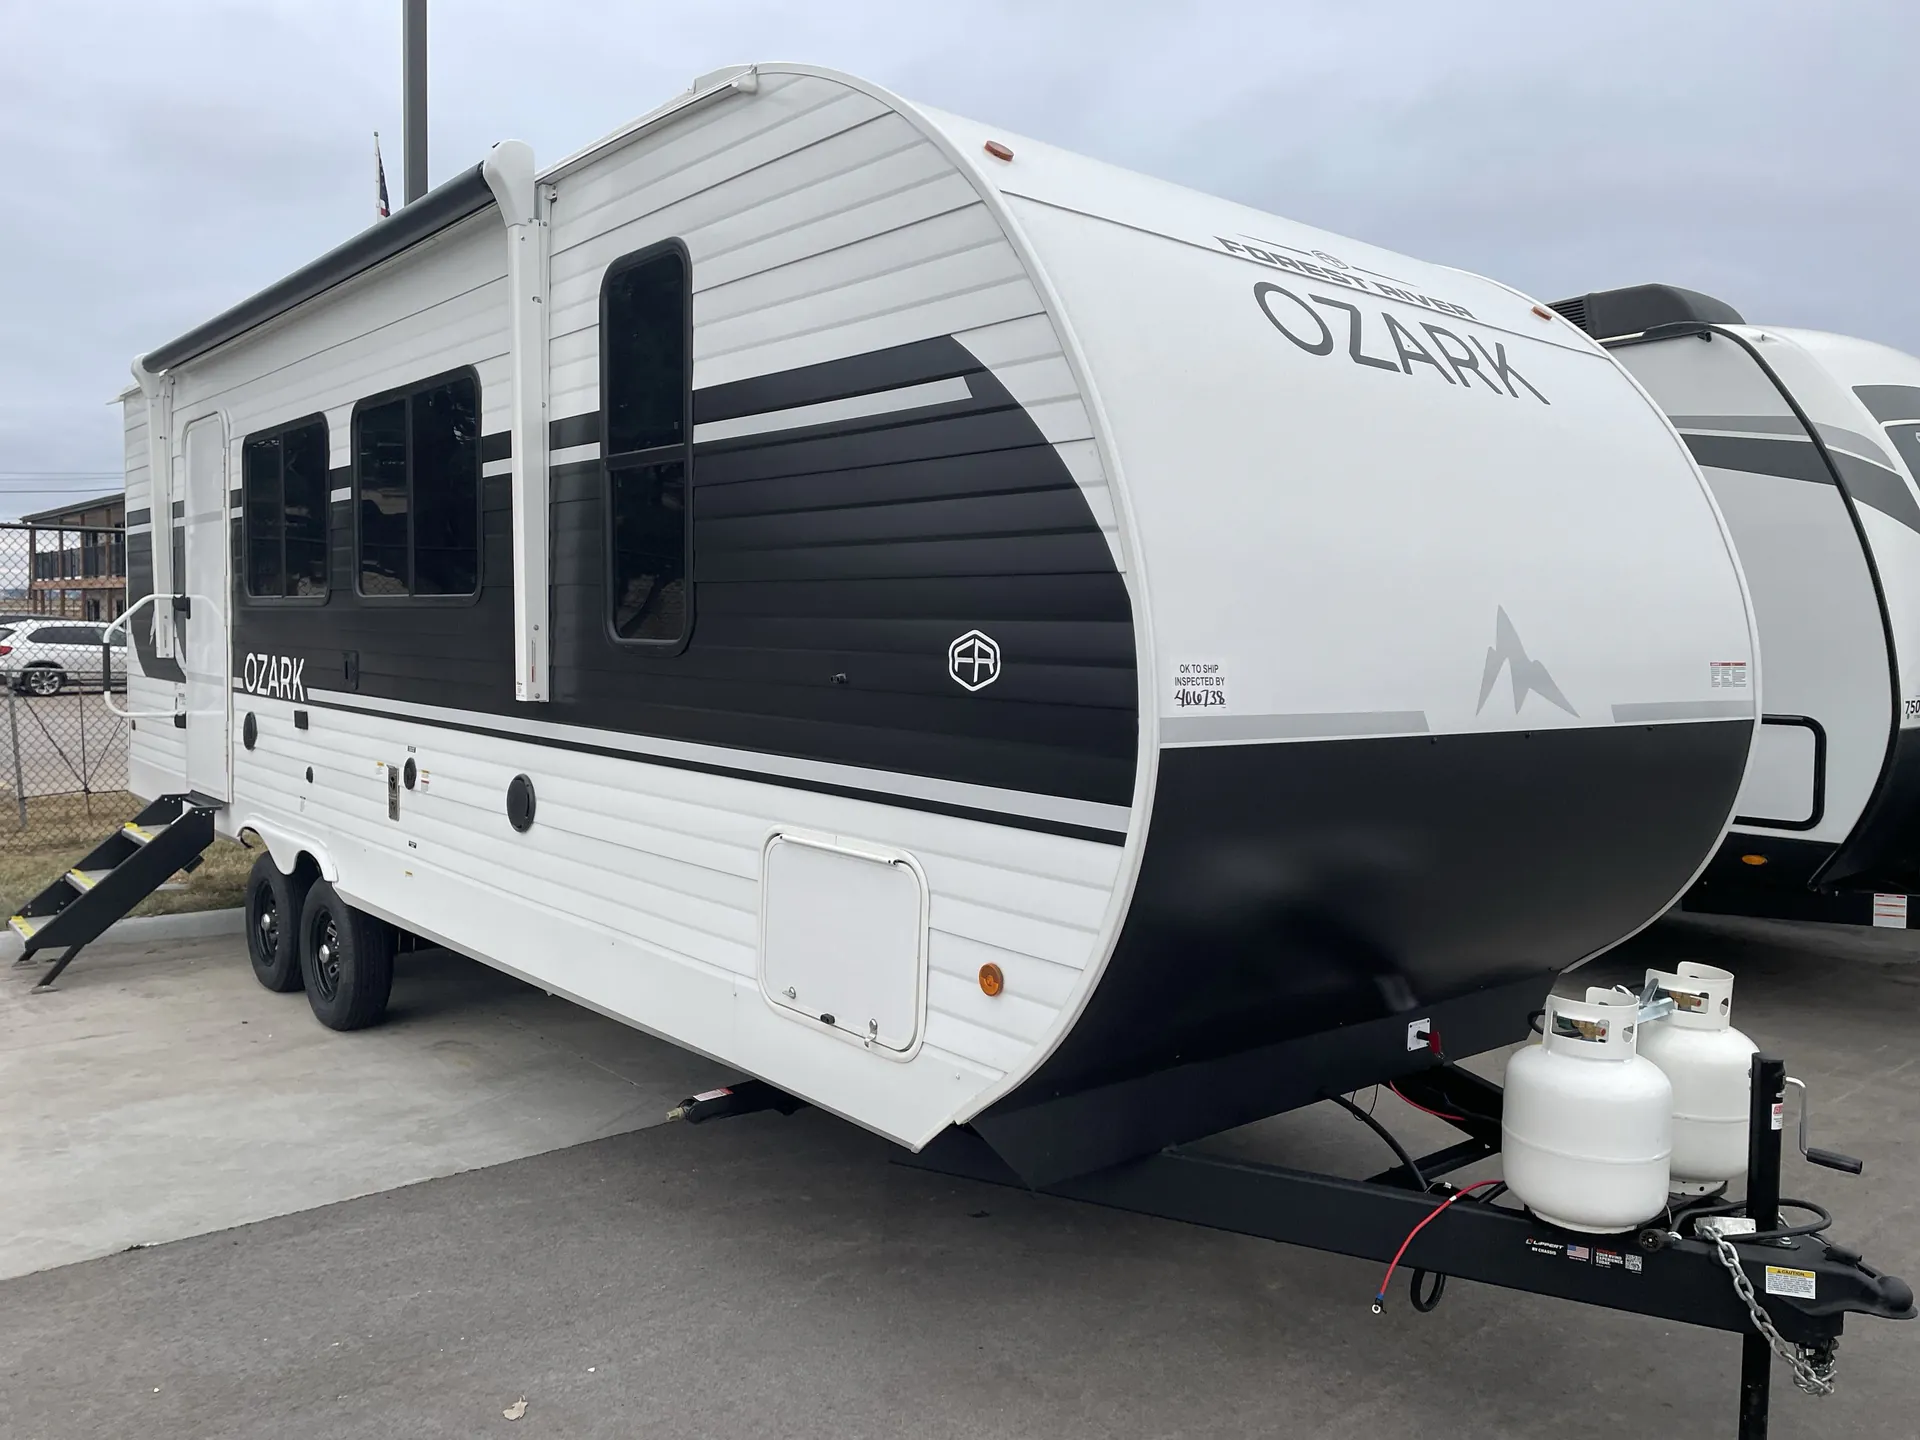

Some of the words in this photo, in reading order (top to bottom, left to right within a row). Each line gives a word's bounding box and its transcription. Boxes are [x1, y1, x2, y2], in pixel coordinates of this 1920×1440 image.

[1212, 235, 1368, 289] FOREST
[1370, 281, 1479, 321] RIVER
[1253, 281, 1551, 405] OZARK
[244, 652, 304, 702] OZARK
[1179, 664, 1190, 674] OK
[1191, 664, 1202, 674] TO
[1203, 664, 1219, 674] SHIP
[1174, 676, 1214, 686] INSPECTED
[1215, 676, 1225, 686] BY
[1174, 688, 1226, 708] 406738
[1781, 1269, 1805, 1277] CAUTION
